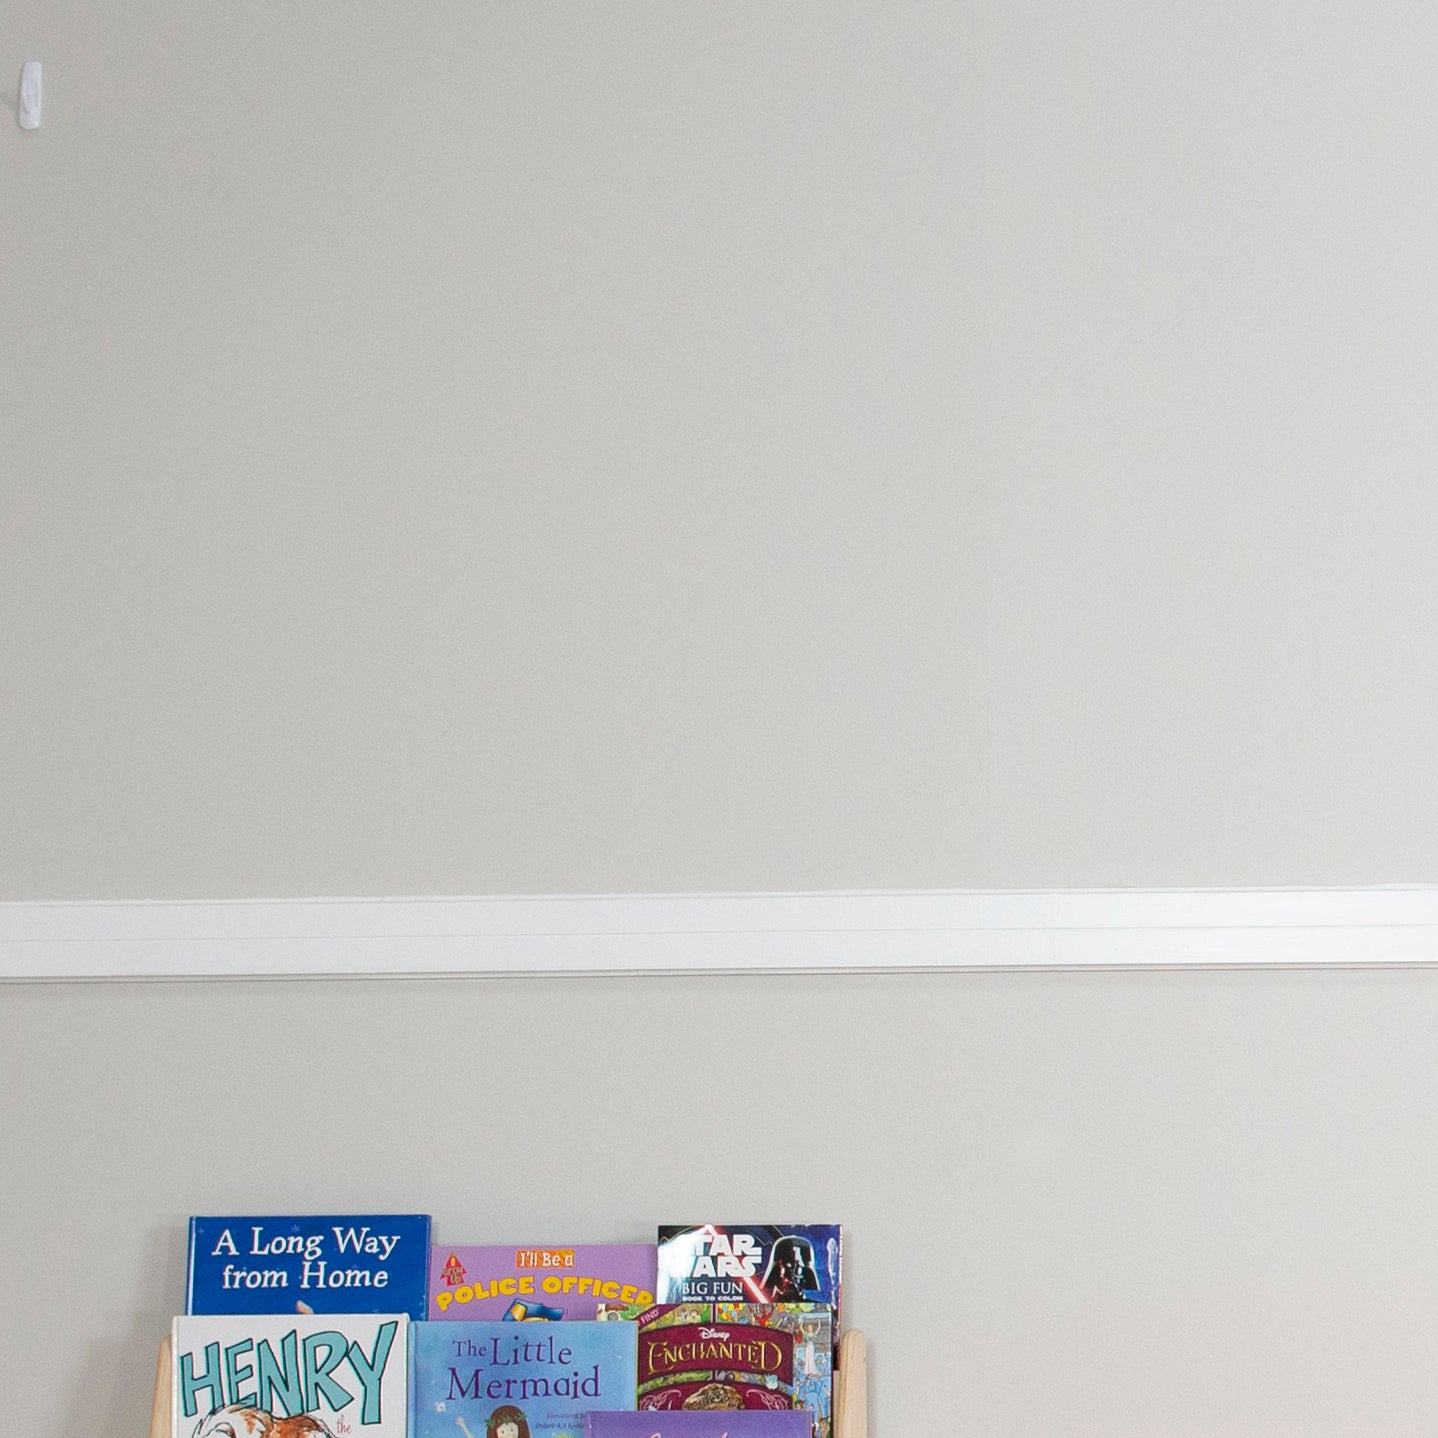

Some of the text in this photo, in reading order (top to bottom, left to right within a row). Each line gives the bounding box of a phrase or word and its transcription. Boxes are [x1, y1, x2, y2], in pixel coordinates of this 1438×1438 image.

[211, 1227, 401, 1261] A Long Way
[696, 1233, 763, 1256] TAR
[519, 1251, 575, 1267] I'll Be a
[693, 1255, 763, 1278] ARS
[222, 1261, 389, 1289] from Home
[436, 1275, 535, 1312] POLICE
[682, 1281, 744, 1295] BIG FUN
[641, 1310, 660, 1325] FIND
[698, 1327, 731, 1340] Disney
[452, 1336, 573, 1366] The Little
[180, 1321, 399, 1425] HENRY
[447, 1365, 602, 1400] Mermaid
